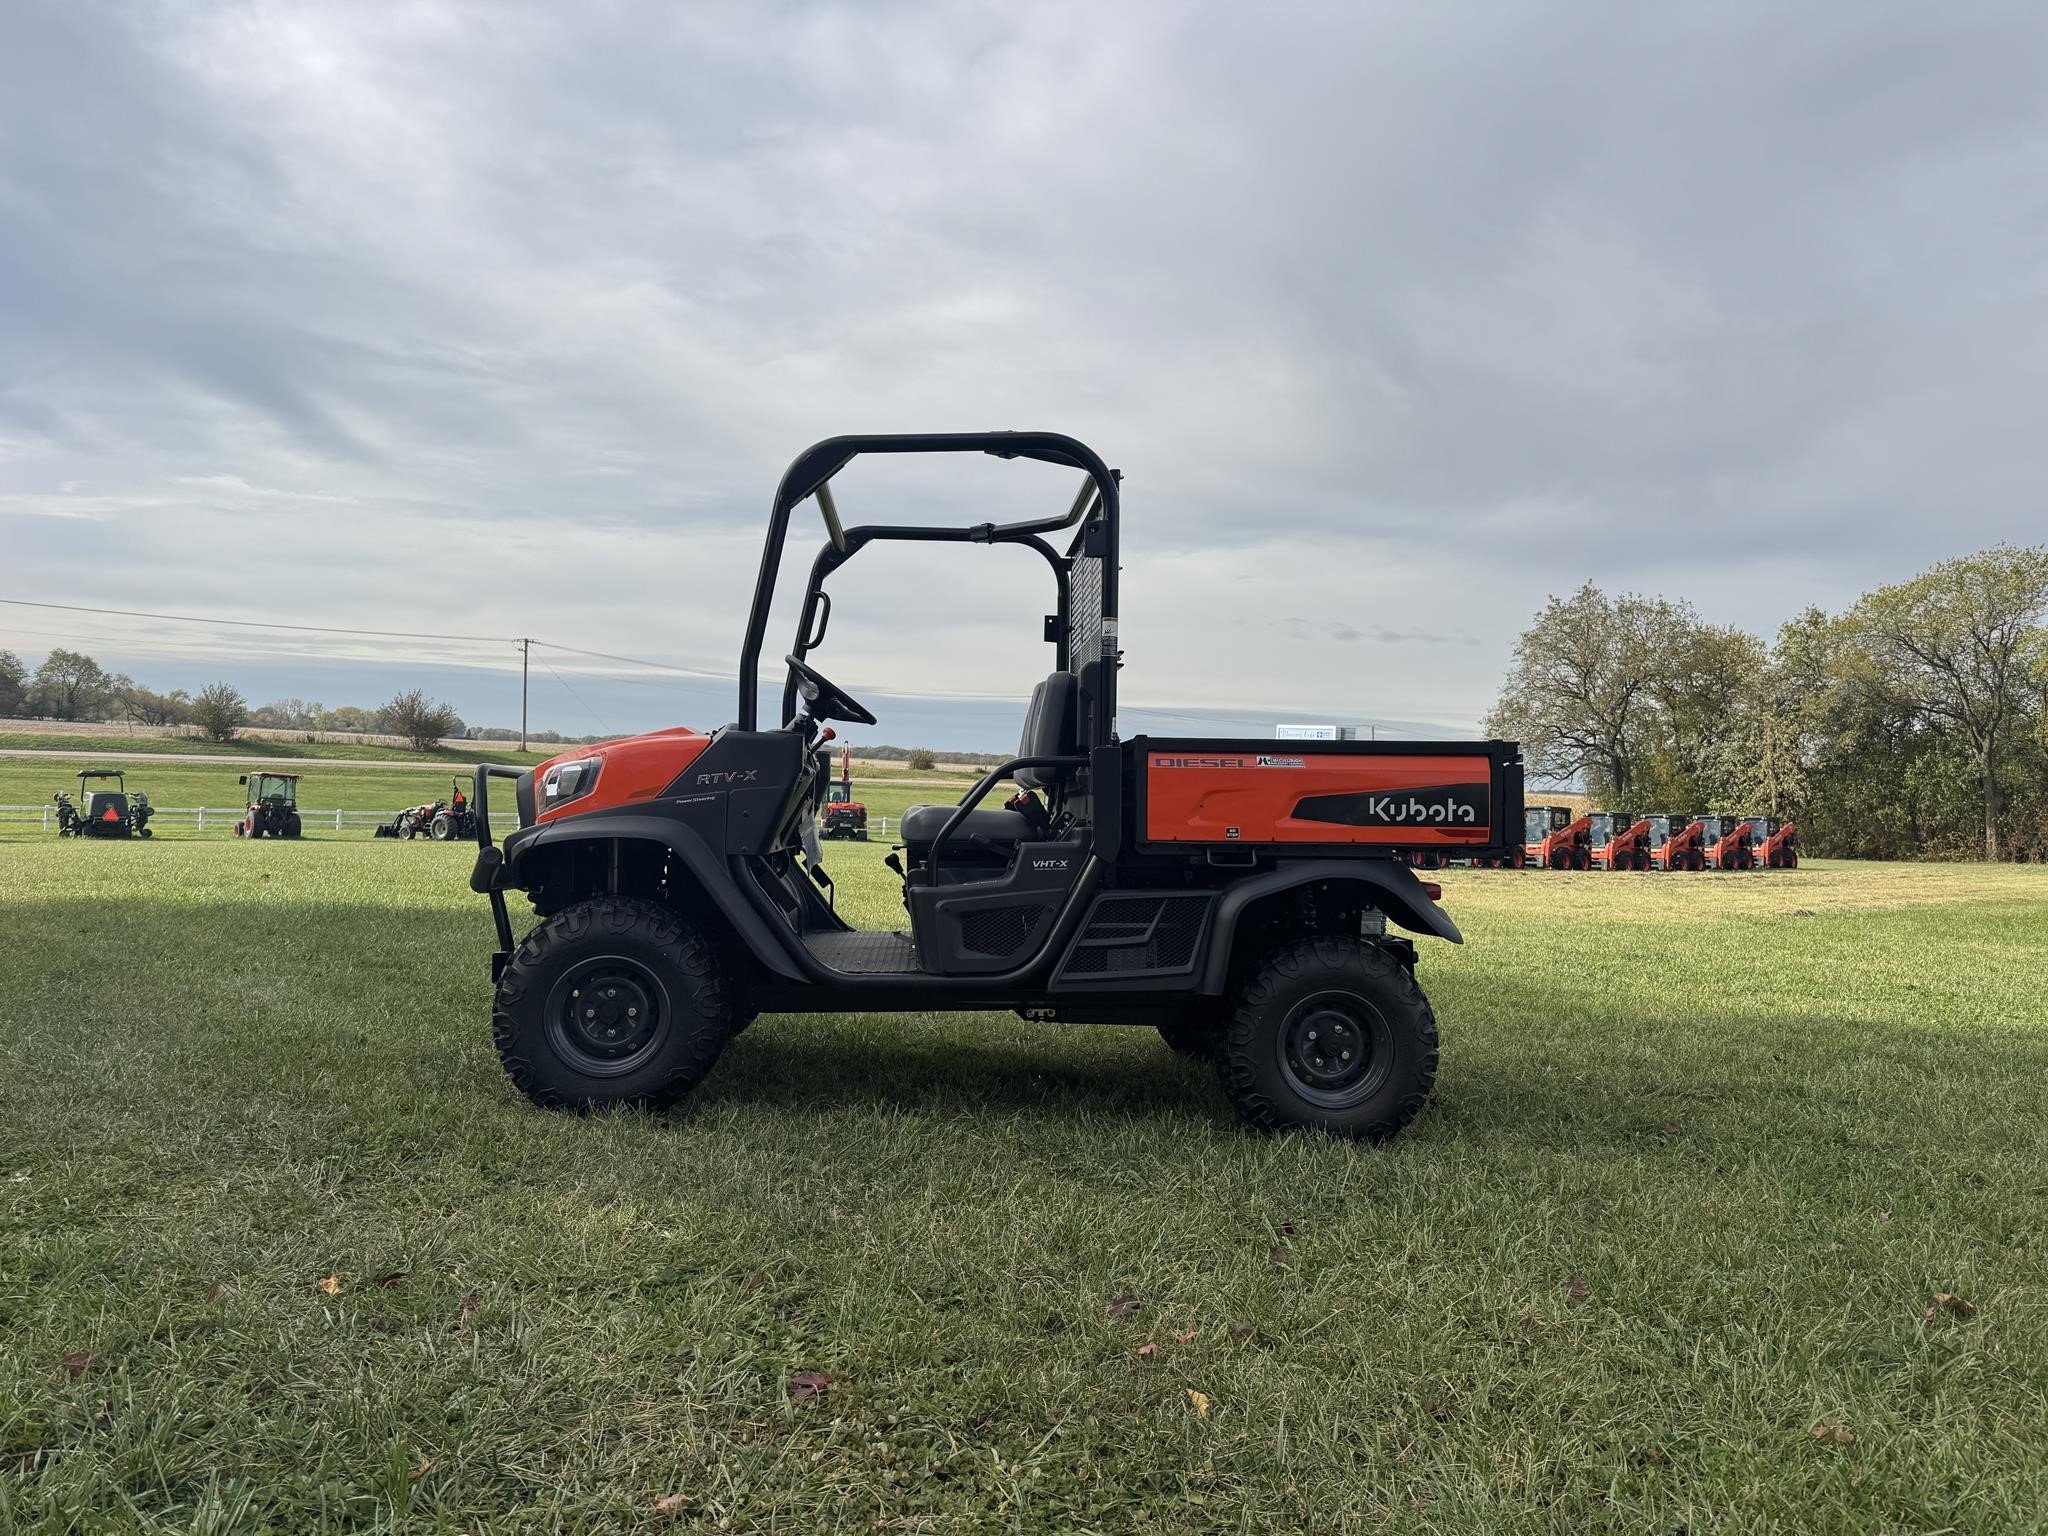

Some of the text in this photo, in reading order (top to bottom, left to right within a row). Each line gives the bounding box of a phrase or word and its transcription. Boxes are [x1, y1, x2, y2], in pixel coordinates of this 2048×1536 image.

[1155, 758, 1255, 768] DIESEL
[696, 769, 758, 785] RTV-X
[1369, 797, 1475, 822] Kubota
[1032, 860, 1068, 868] VHT-X
